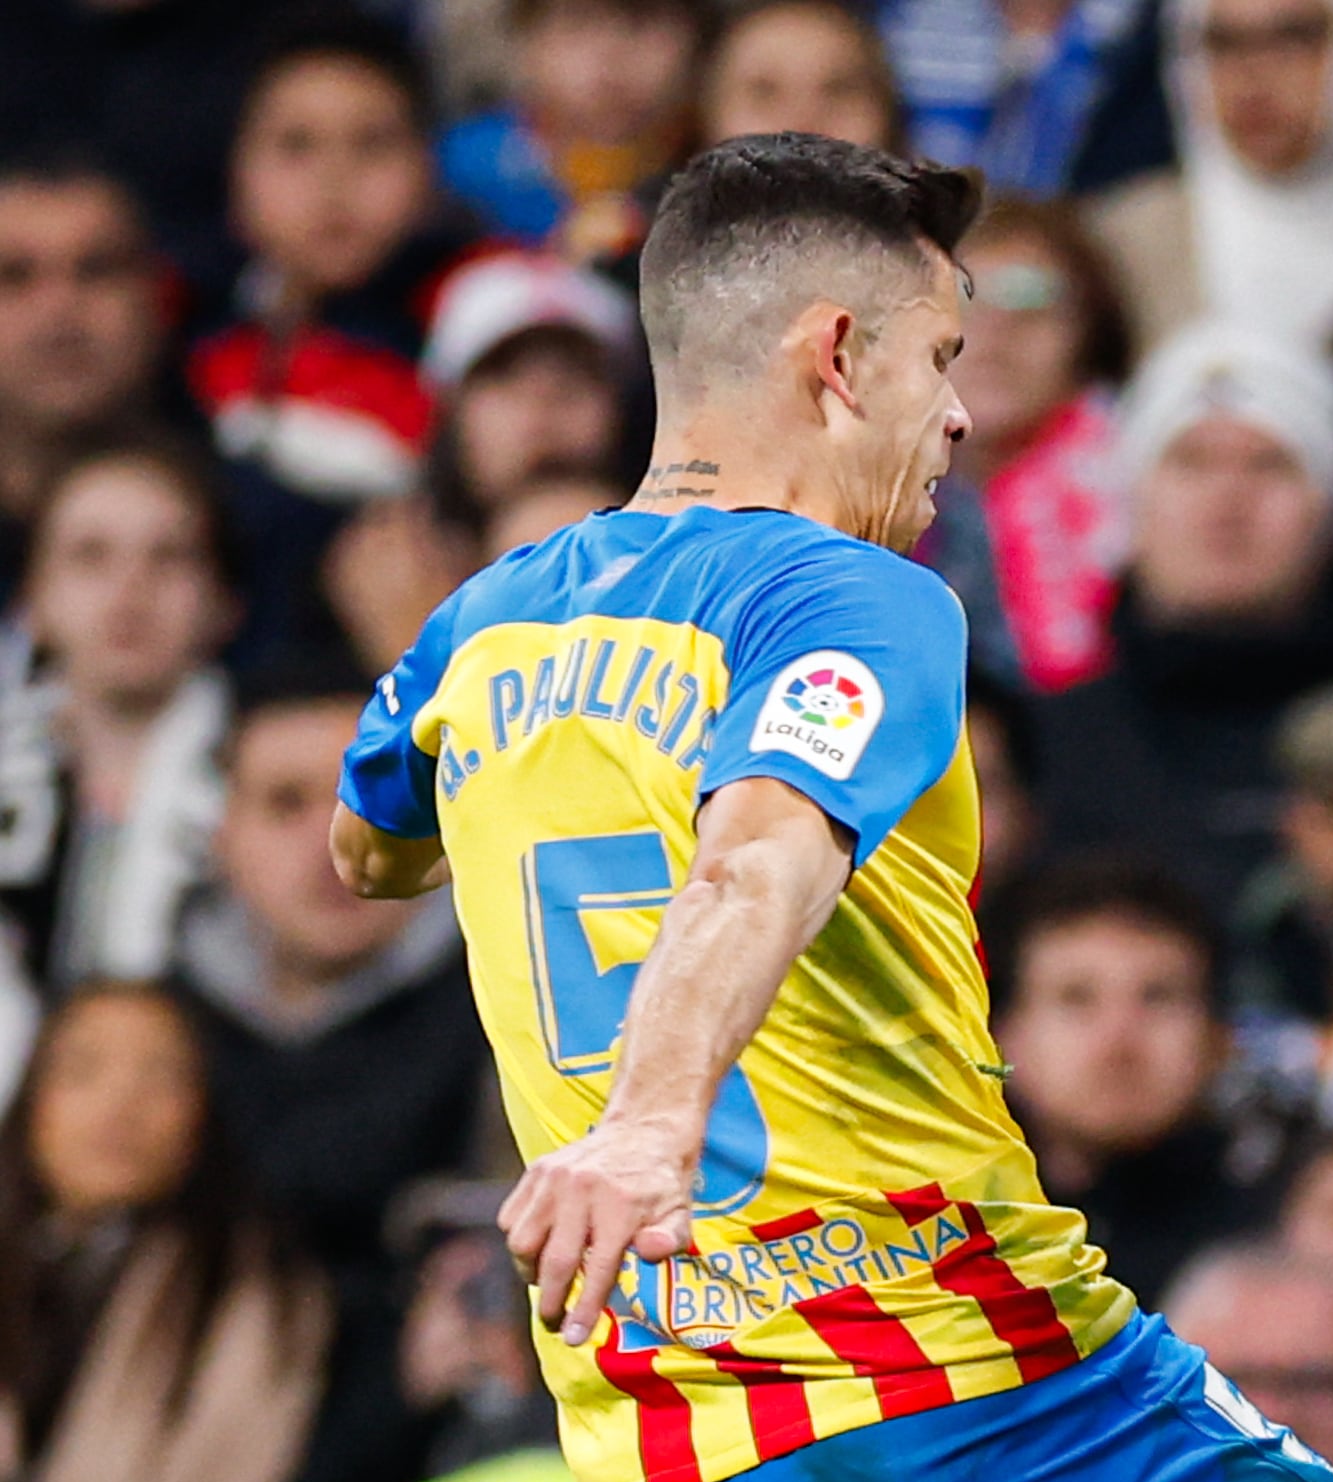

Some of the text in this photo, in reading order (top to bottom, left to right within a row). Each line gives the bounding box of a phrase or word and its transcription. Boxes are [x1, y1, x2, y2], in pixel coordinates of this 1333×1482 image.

[487, 638, 718, 771] PAULISTA
[764, 720, 845, 763] LaLiga
[674, 1215, 967, 1325] BRIGANTINA
